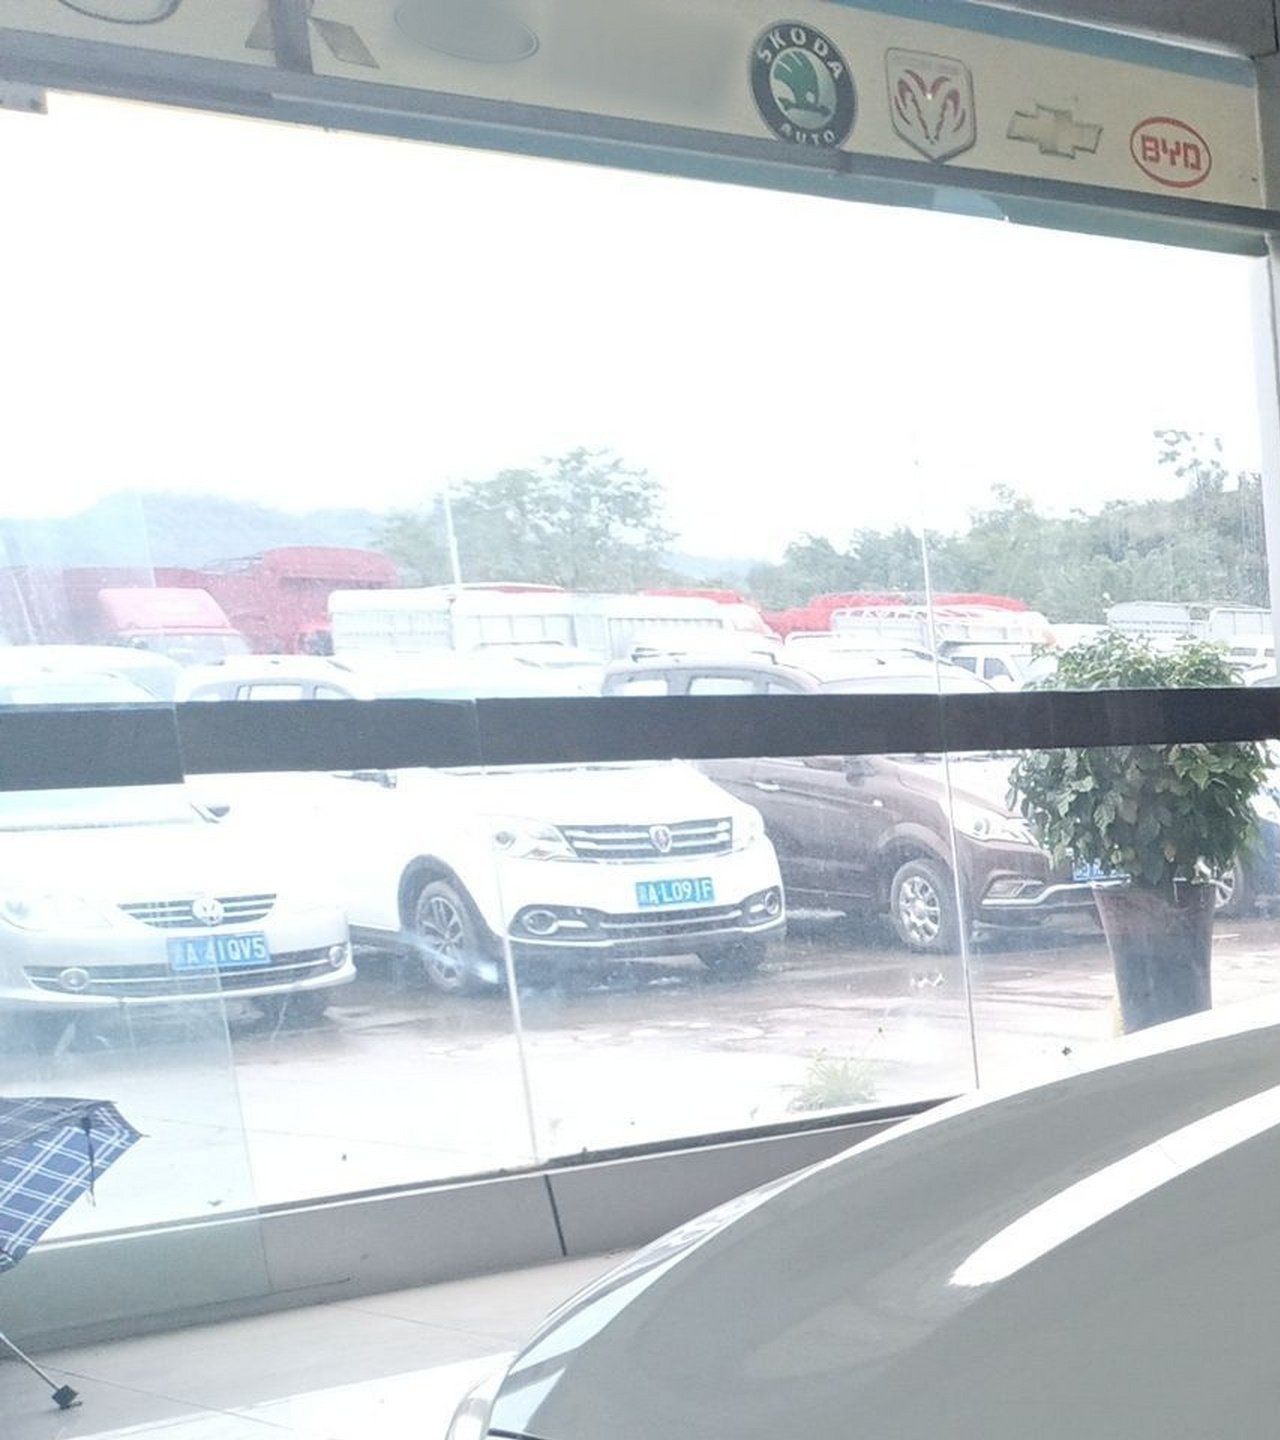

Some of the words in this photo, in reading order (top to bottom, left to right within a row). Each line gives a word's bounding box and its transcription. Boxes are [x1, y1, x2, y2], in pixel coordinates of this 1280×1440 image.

[757, 27, 845, 79] SKODA
[781, 124, 837, 147] AUTO
[1140, 133, 1202, 171] BYD
